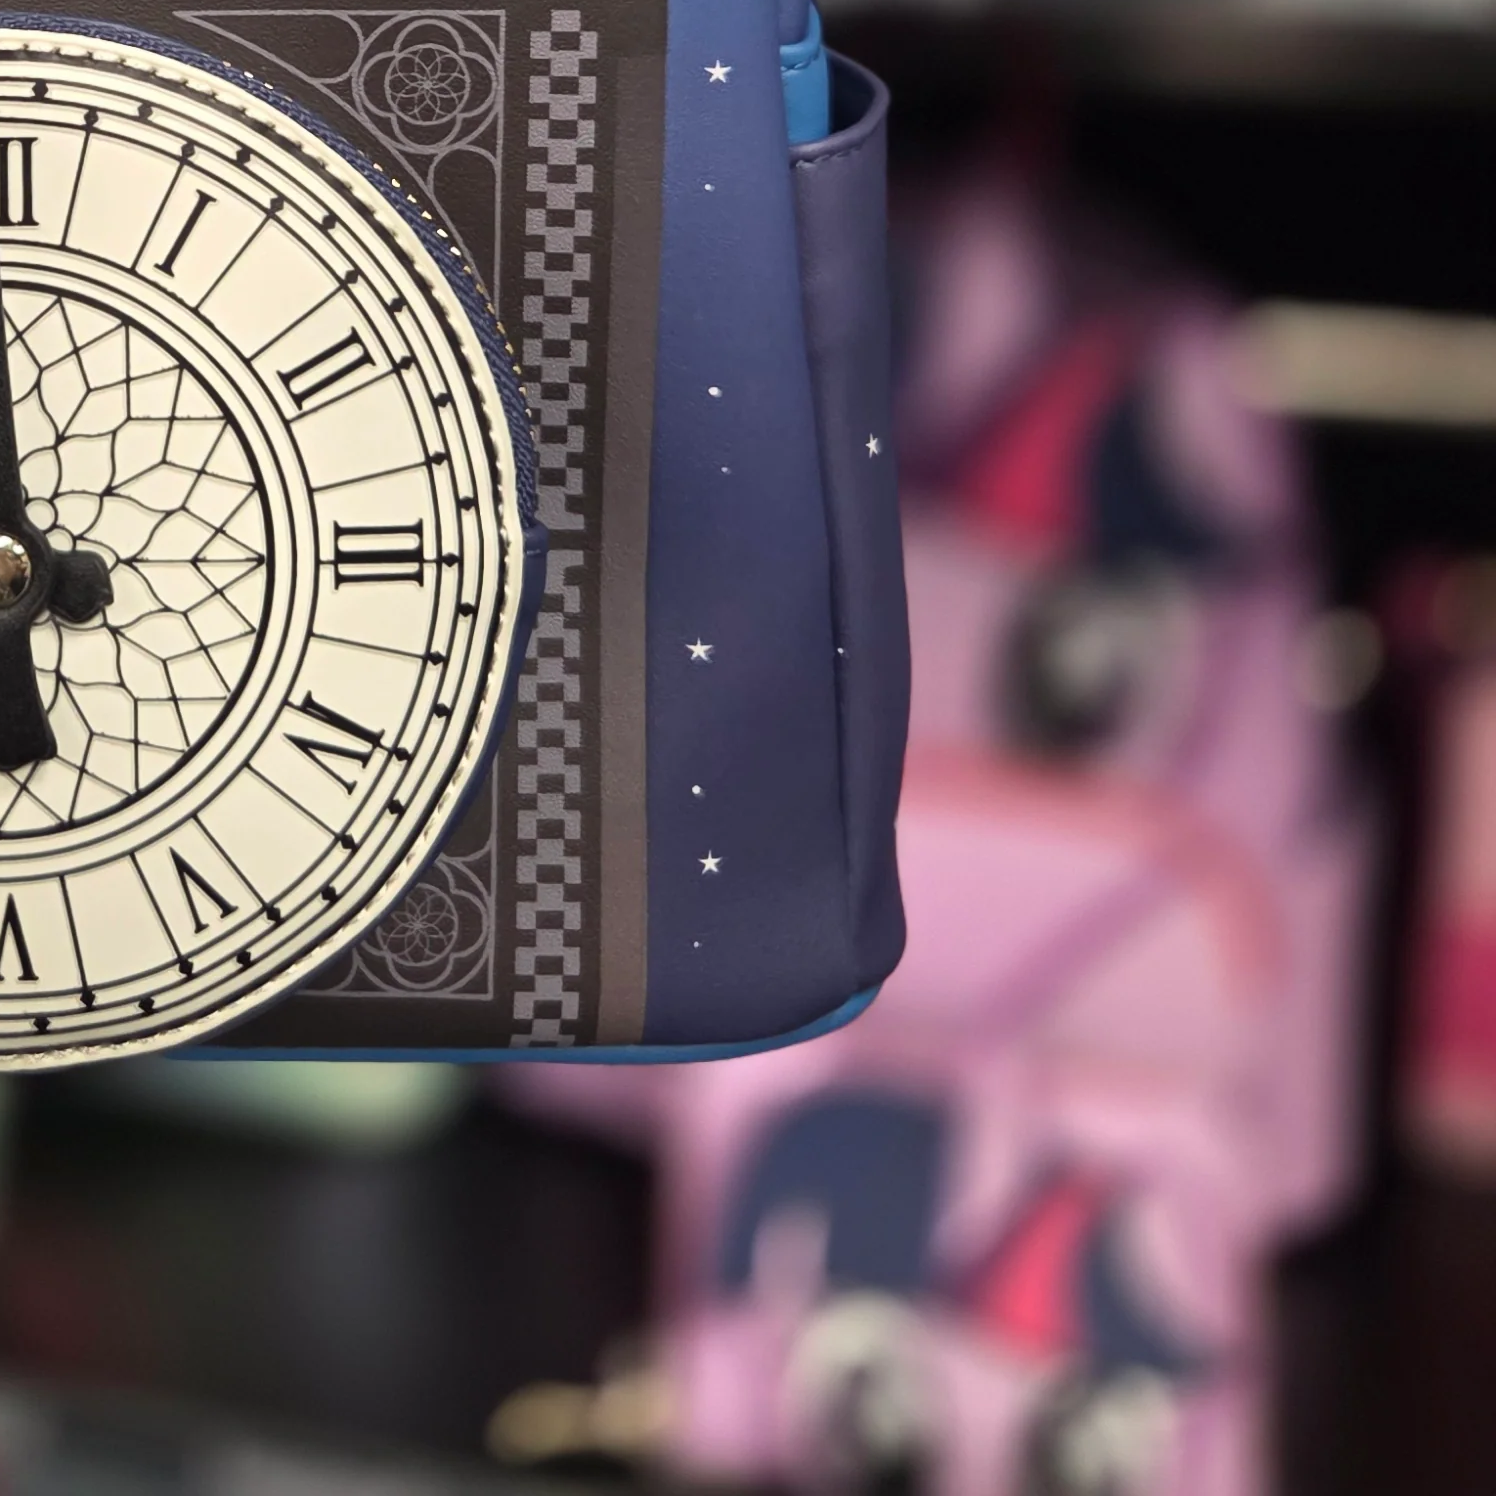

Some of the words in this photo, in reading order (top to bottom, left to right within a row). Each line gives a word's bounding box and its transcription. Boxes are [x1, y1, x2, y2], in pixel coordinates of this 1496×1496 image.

[153, 188, 217, 278] I
[276, 325, 377, 411] II
[333, 517, 423, 590] III
[282, 690, 385, 796] IV
[169, 846, 239, 934] V
